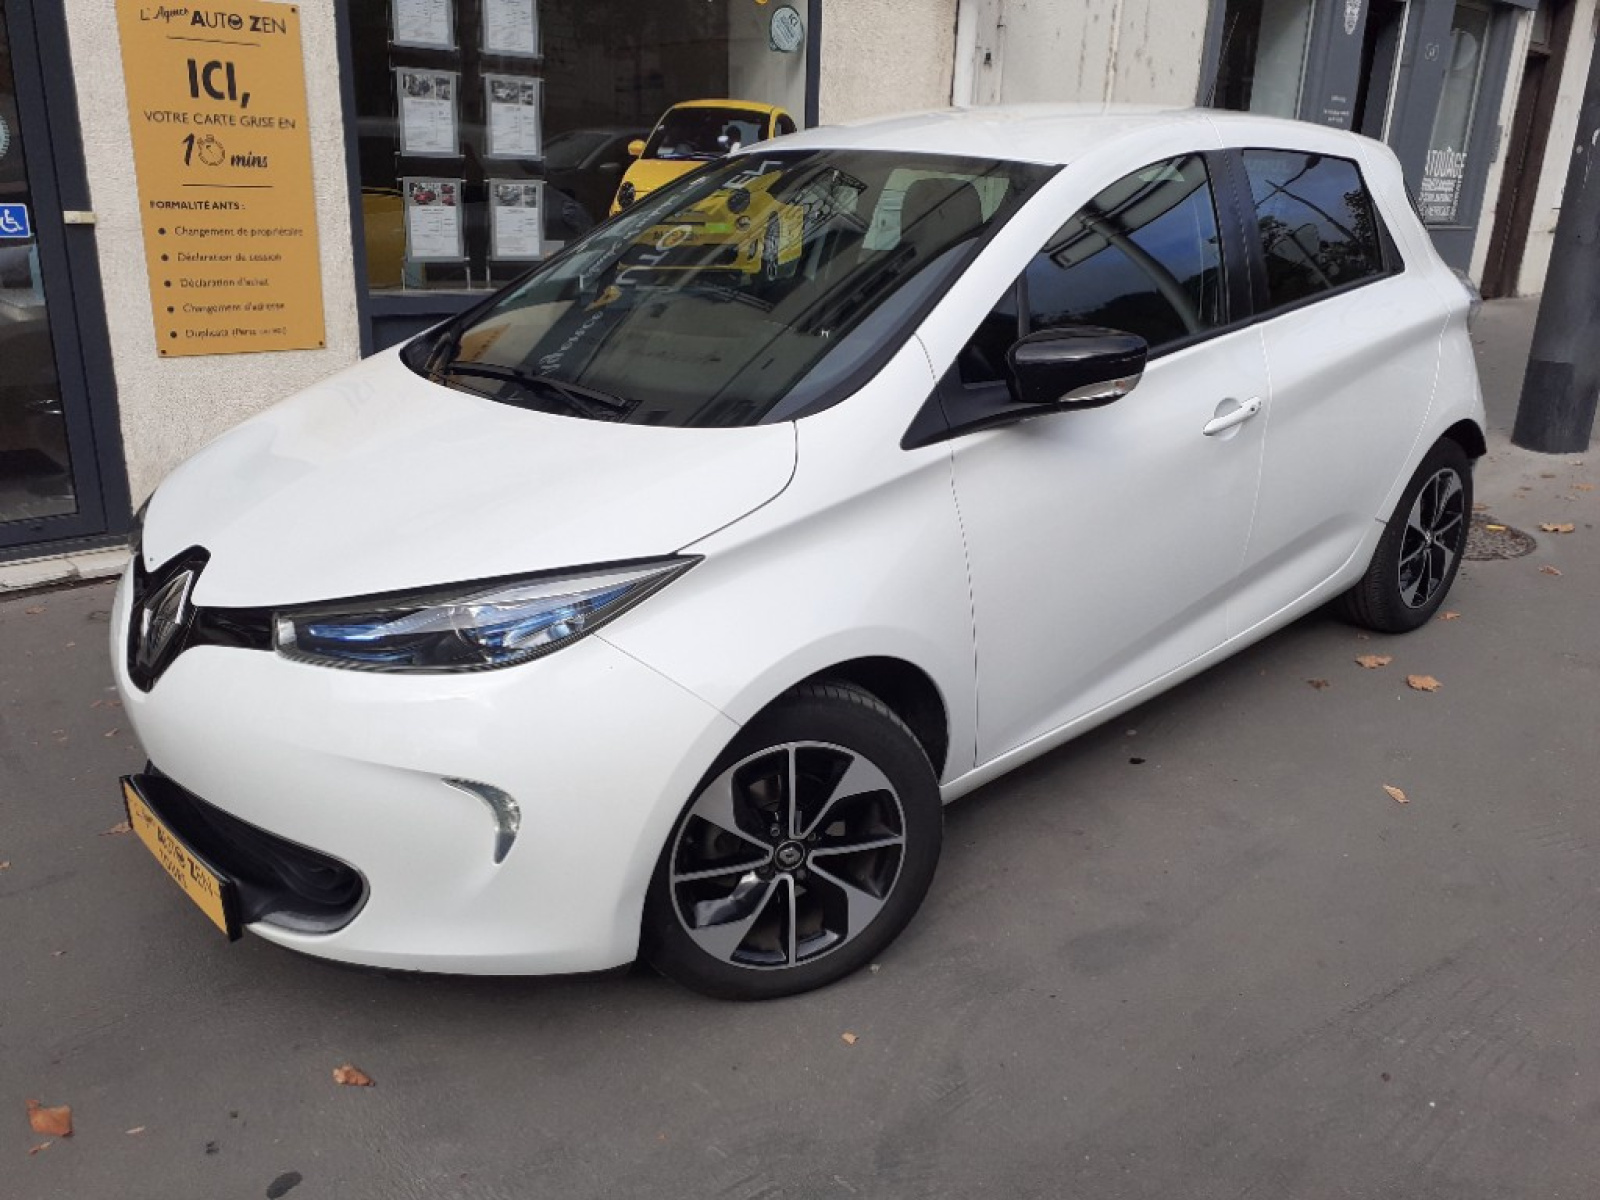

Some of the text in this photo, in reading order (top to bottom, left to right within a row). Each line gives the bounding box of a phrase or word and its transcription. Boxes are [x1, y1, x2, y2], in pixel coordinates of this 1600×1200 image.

[190, 10, 243, 31] AUTO
[249, 15, 287, 35] ZEN
[187, 58, 251, 109] ICI,
[144, 110, 296, 129] VOTRE CARTE GRISE EN
[230, 152, 268, 168] mins
[174, 226, 234, 238] Changement
[237, 227, 249, 237] de
[177, 252, 232, 262] Déclaration
[180, 278, 235, 288] Déclaration
